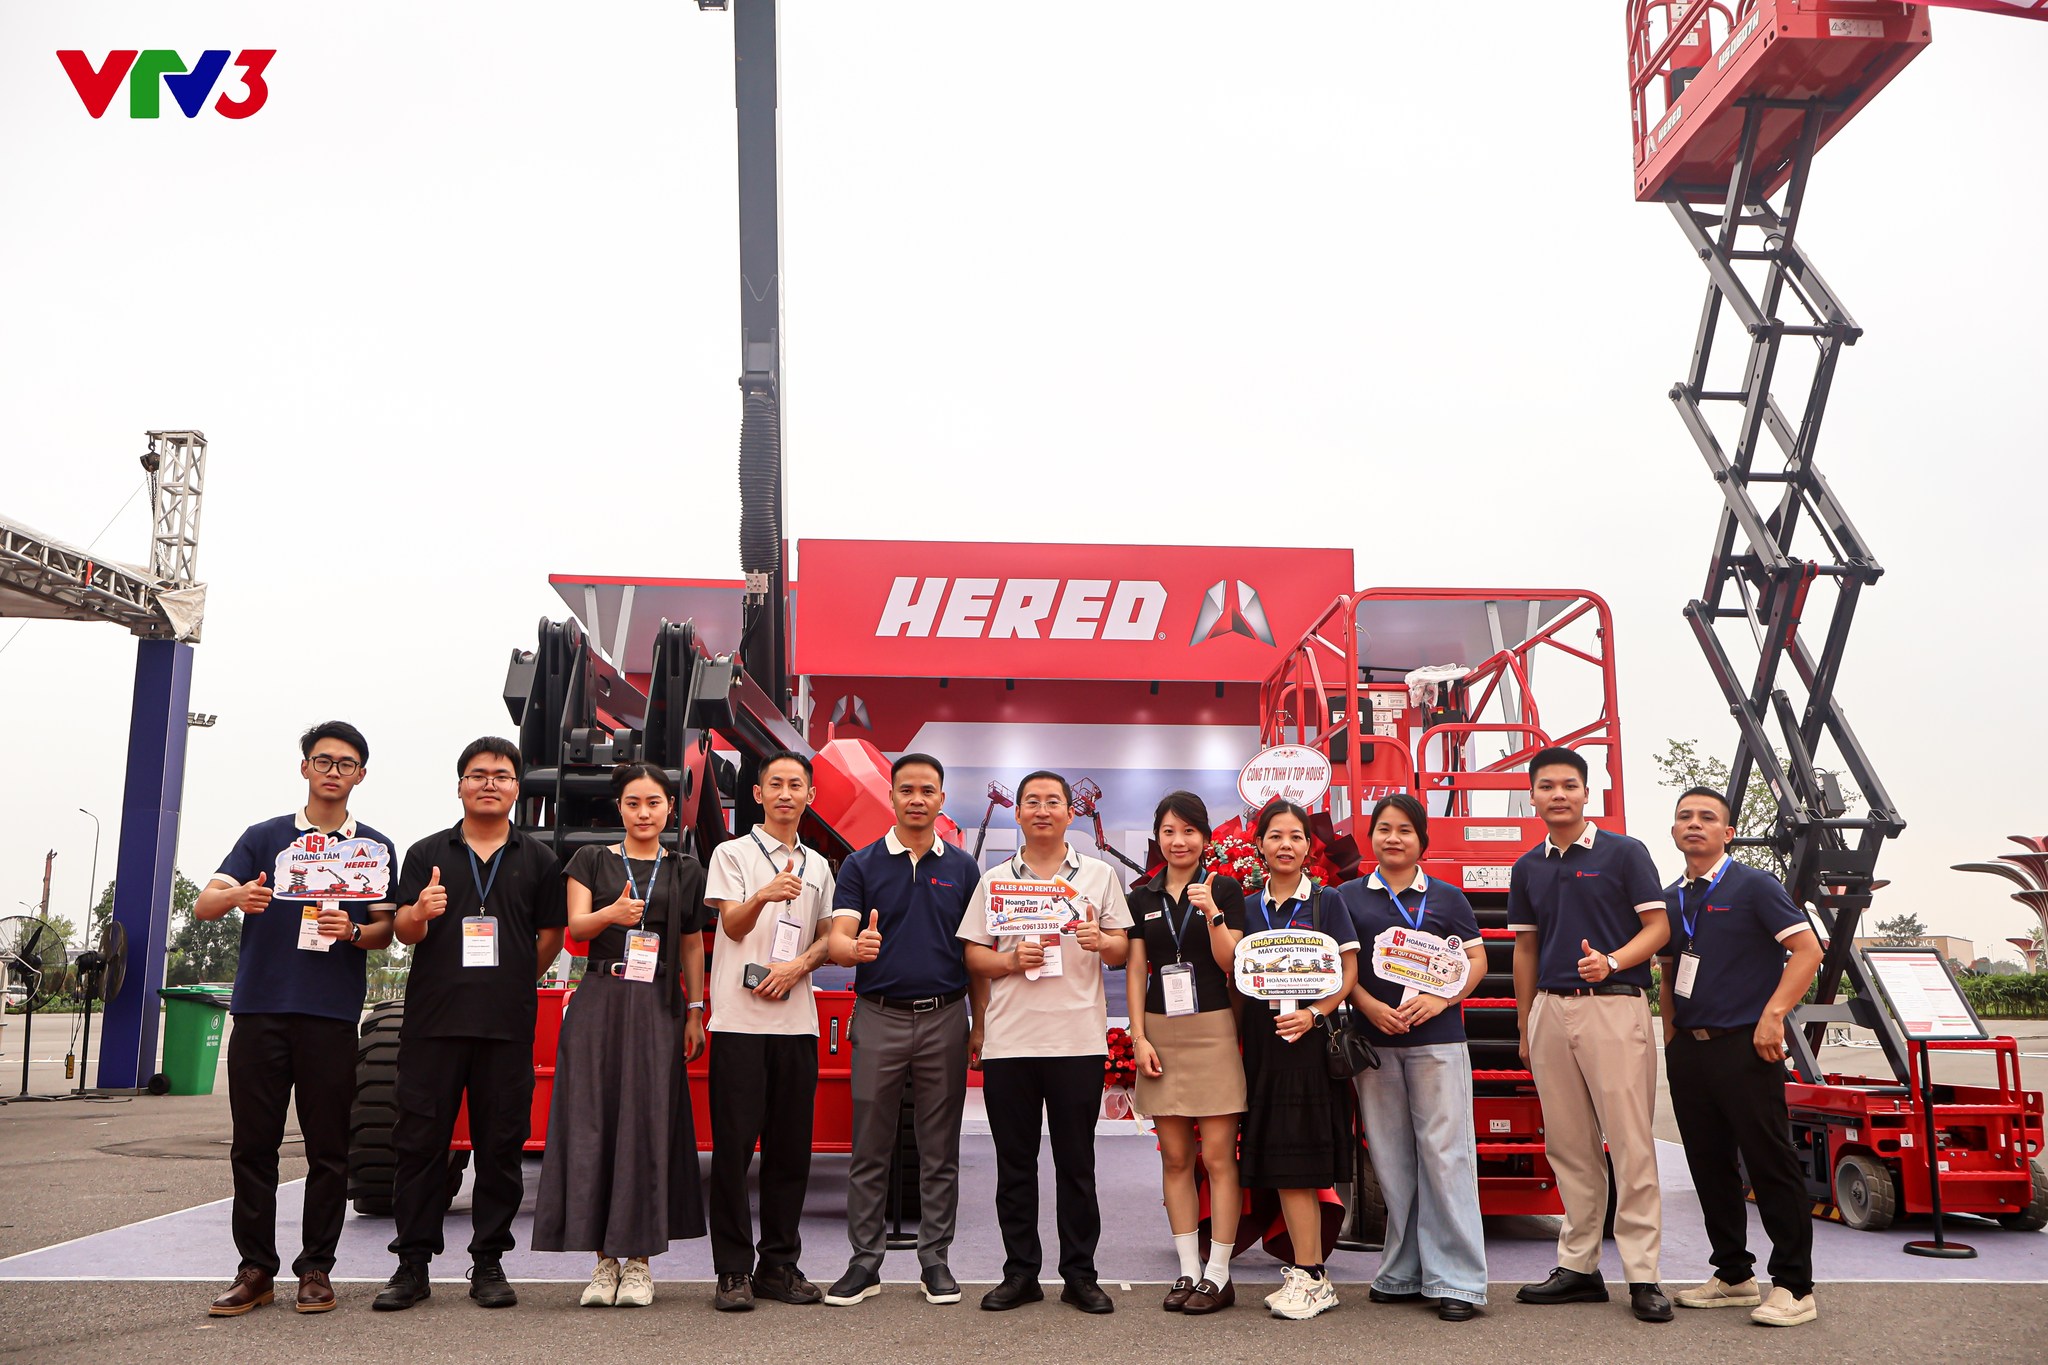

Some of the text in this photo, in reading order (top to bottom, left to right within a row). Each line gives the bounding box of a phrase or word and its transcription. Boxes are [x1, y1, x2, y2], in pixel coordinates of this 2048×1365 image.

[875, 577, 1168, 641] HERED
[1247, 764, 1325, 781] CÔNG TY TNHH V TOP HOUSE
[1362, 786, 1400, 800] RED
[292, 852, 320, 861] HOÀNG
[1252, 938, 1274, 947] NHẬP
[1406, 970, 1420, 978] 0961
[1420, 973, 1430, 981] 333
